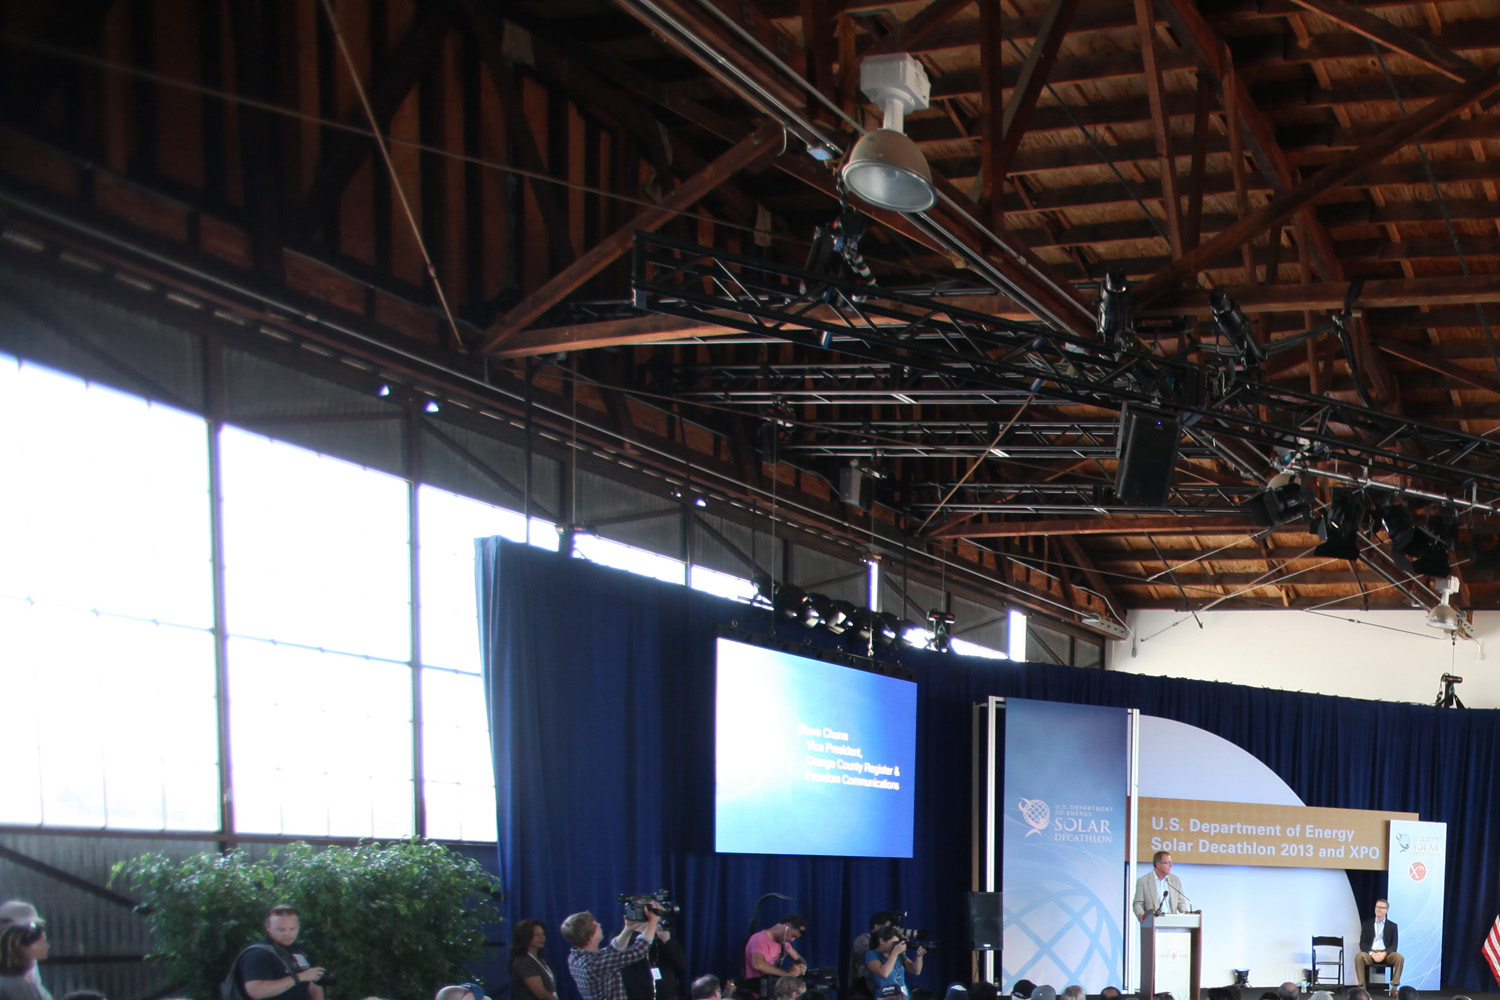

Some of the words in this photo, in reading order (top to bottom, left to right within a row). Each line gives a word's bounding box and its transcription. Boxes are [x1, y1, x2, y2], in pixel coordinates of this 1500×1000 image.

[806, 740, 825, 752] Vice
[825, 742, 863, 758] President,
[806, 755, 836, 770] Orange
[836, 758, 863, 774] County
[864, 762, 894, 777] Register
[893, 765, 901, 777] &
[805, 770, 841, 784] Freedom
[841, 774, 900, 791] Communications
[1070, 804, 1113, 812] DEPARTMENT
[1054, 817, 1112, 834] SOLAR
[1151, 816, 1184, 831] U.S.
[1189, 818, 1281, 836] Department
[1286, 824, 1302, 837] of
[1305, 825, 1355, 842] Energy
[1054, 833, 1112, 843] DECATHLON
[1151, 837, 1194, 852] Solar
[1198, 839, 1276, 856] Decathlon
[1280, 843, 1314, 857] 2013
[1318, 845, 1345, 858] and
[1349, 846, 1380, 859] XPO
